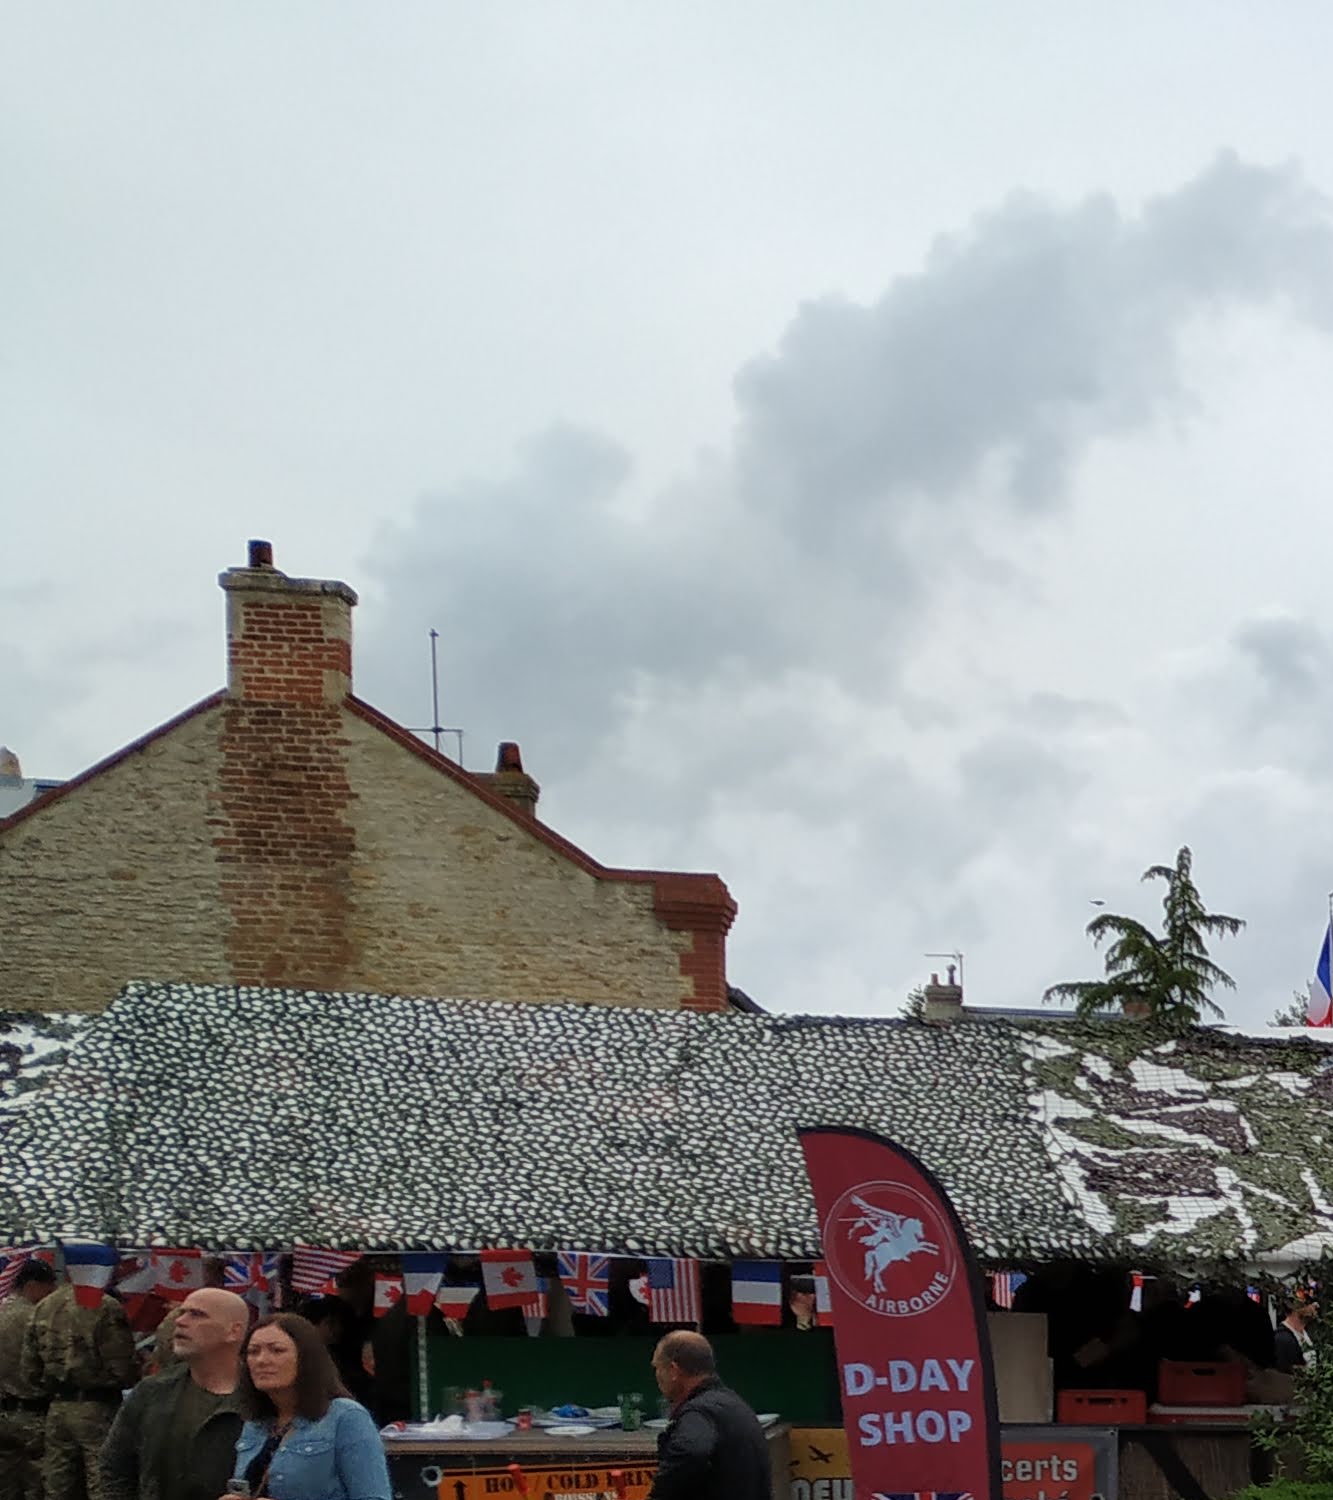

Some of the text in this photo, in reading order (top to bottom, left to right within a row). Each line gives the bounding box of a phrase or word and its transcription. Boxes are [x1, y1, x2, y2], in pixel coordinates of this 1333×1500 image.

[865, 1271, 950, 1314] AIRBORNE
[843, 1359, 975, 1396] D-DAY
[858, 1410, 971, 1447] SHOP
[485, 1477, 515, 1493] HO
[547, 1473, 598, 1489] COLD
[1001, 1455, 1078, 1482] certs
